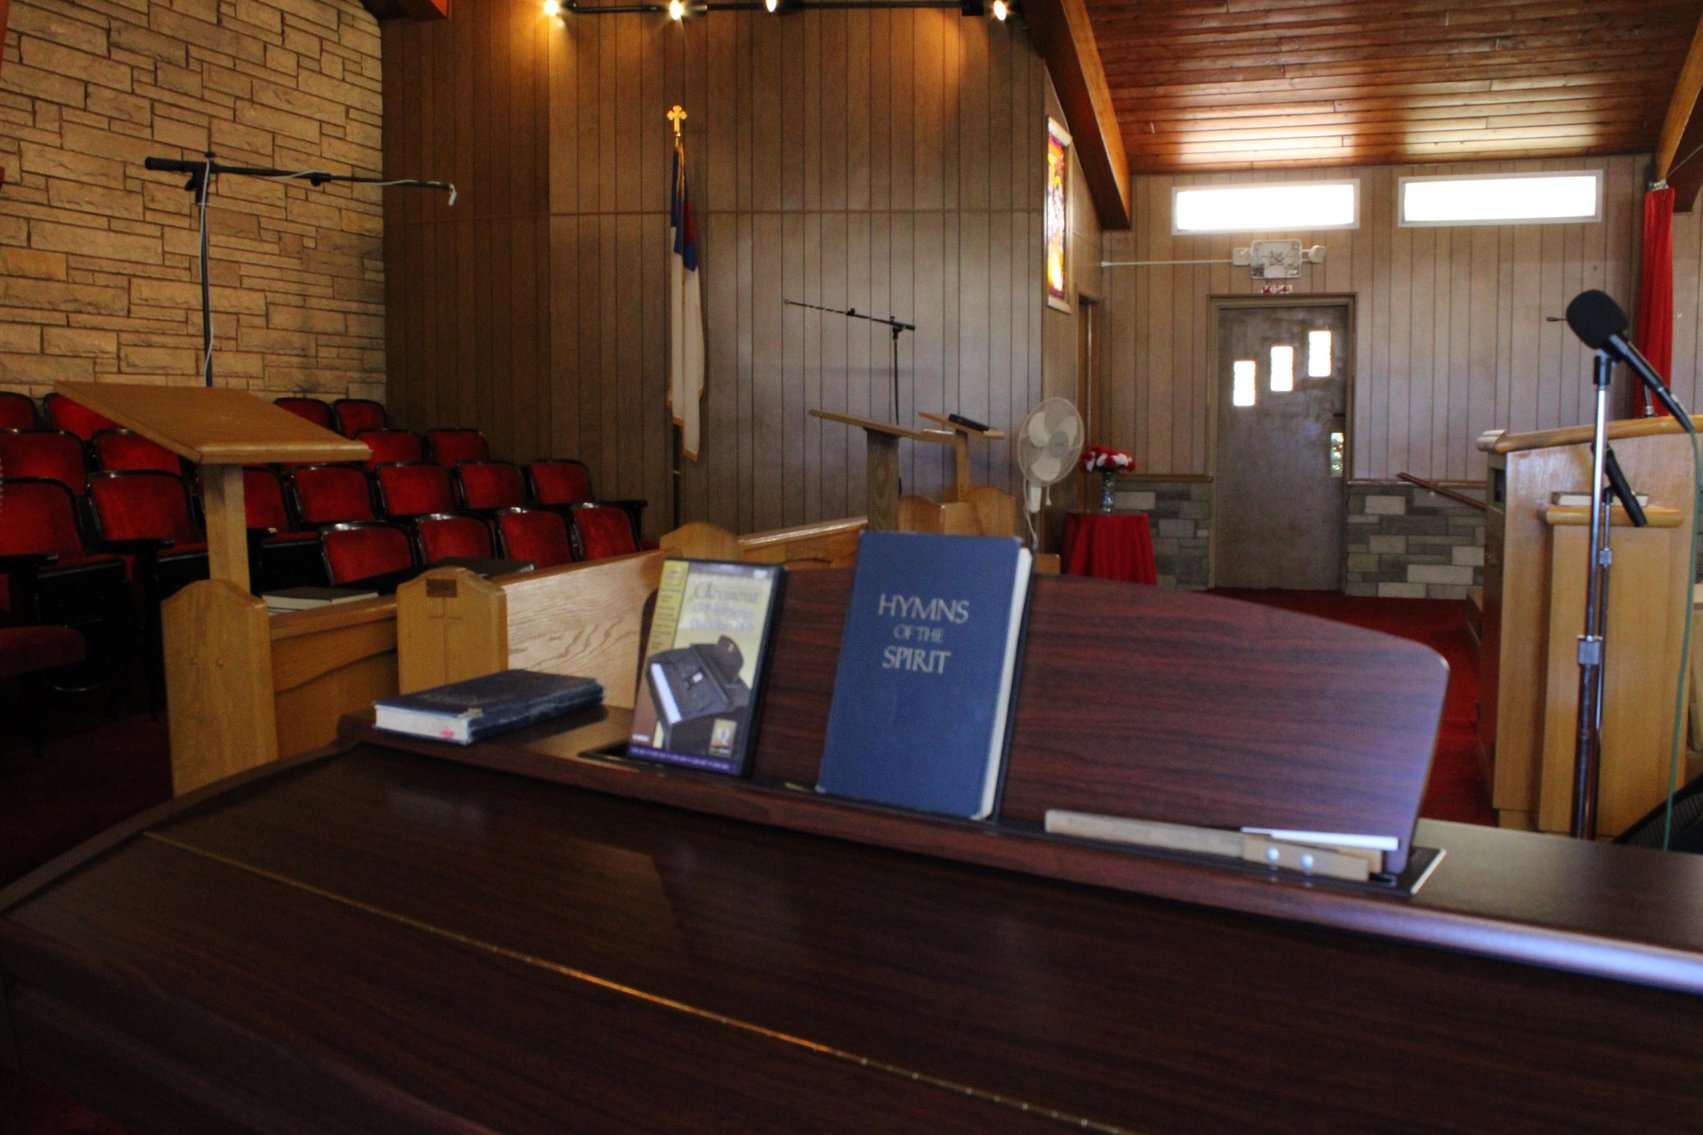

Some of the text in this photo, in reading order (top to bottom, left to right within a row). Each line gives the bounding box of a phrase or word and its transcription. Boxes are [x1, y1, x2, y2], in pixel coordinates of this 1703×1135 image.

[878, 593, 970, 624] HYMNS
[893, 624, 944, 644] OF THE
[882, 645, 952, 674] SPIRIT
